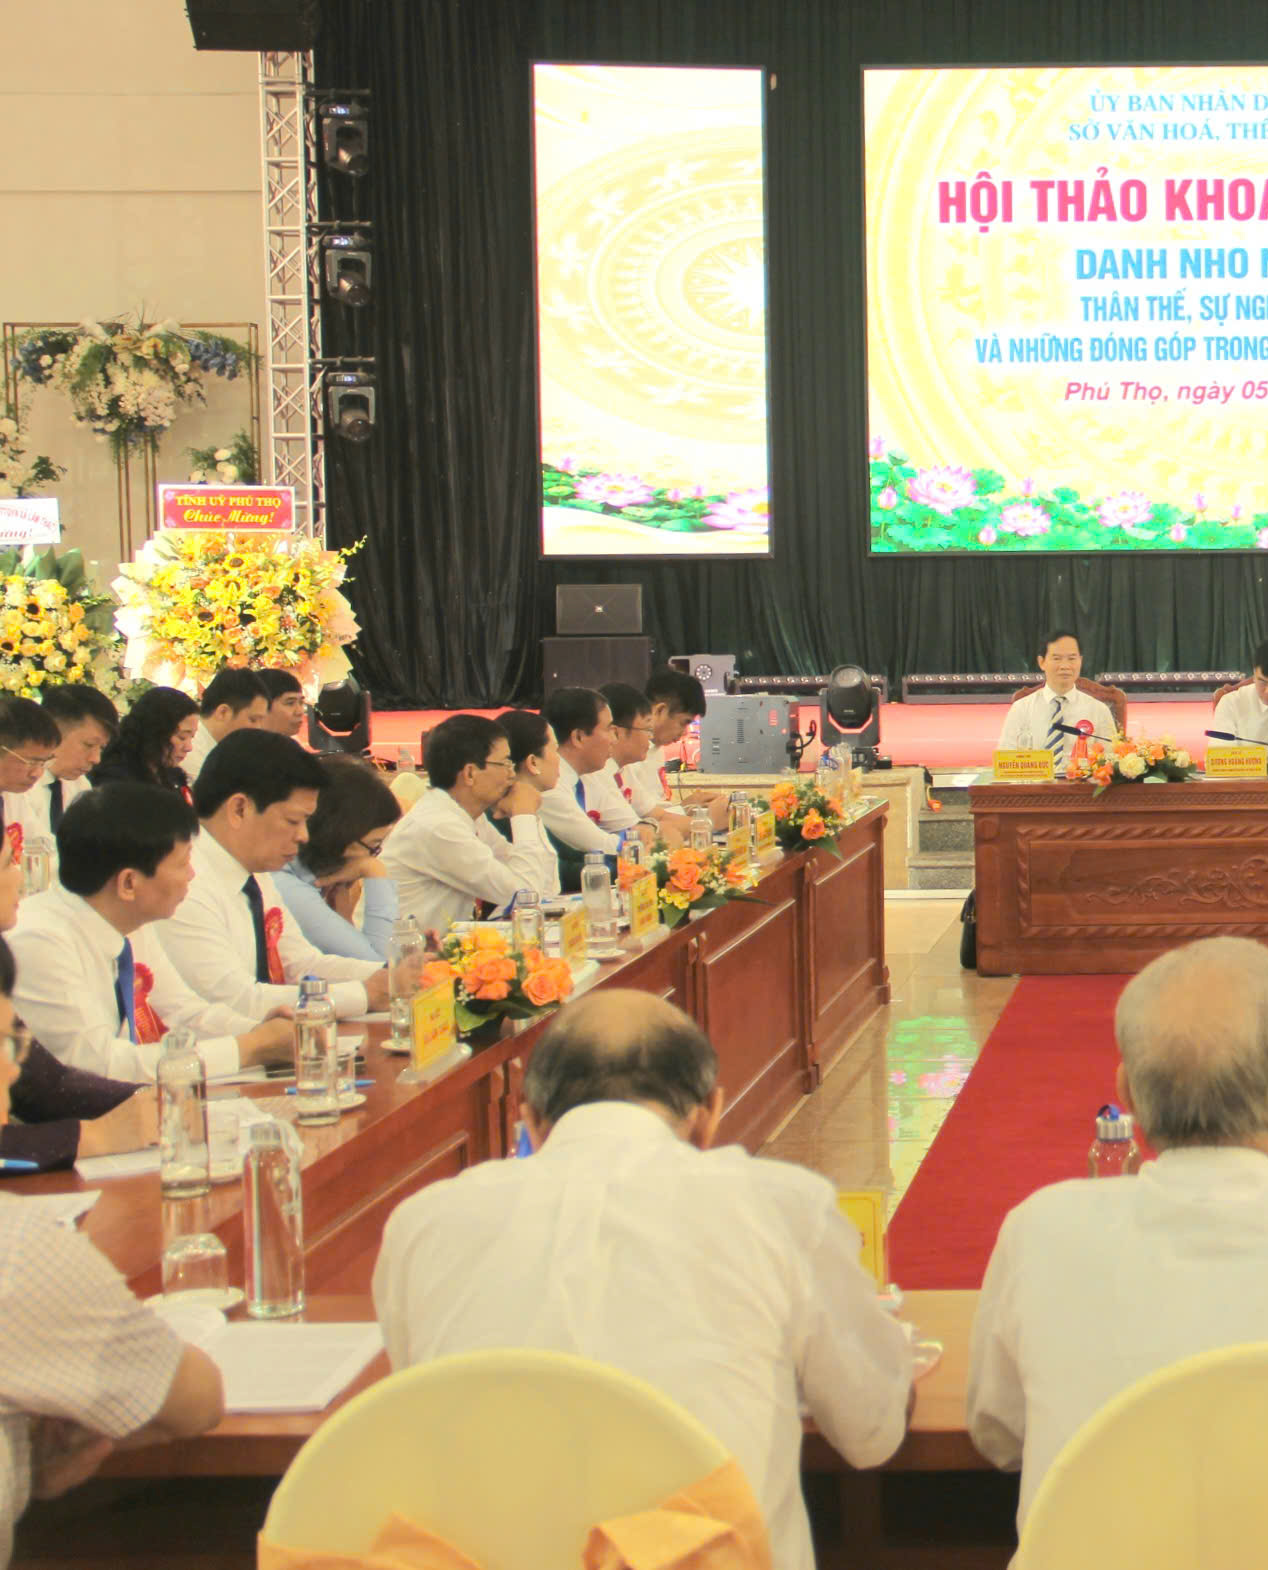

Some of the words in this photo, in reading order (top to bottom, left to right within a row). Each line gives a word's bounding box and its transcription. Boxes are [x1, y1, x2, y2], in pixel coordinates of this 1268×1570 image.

[1128, 94, 1174, 112] BAN
[1181, 89, 1245, 112] NHÂN
[1069, 118, 1100, 141] SỞ
[1107, 119, 1154, 141] VĂN
[1162, 118, 1220, 142] HOÁ,
[939, 171, 1013, 233] HỘI
[1030, 167, 1148, 222] THẢO
[1075, 248, 1168, 280] DANH
[1180, 247, 1250, 279] NHO
[1080, 290, 1139, 322] THÂN
[1146, 288, 1193, 324] THẾ,
[1200, 292, 1230, 326] SỰ
[975, 333, 1003, 363] VÀ
[1009, 332, 1083, 363] NHỮNG
[1090, 331, 1148, 363] ĐÓNG
[1154, 332, 1196, 362] GÓP
[1065, 382, 1110, 401] Phú
[1120, 381, 1169, 405] Thọ,
[1177, 380, 1235, 405] ngày
[1242, 381, 1268, 400] 05
[229, 494, 254, 506] PHÚ
[256, 497, 281, 509] THỌ
[184, 509, 221, 523] Chúc
